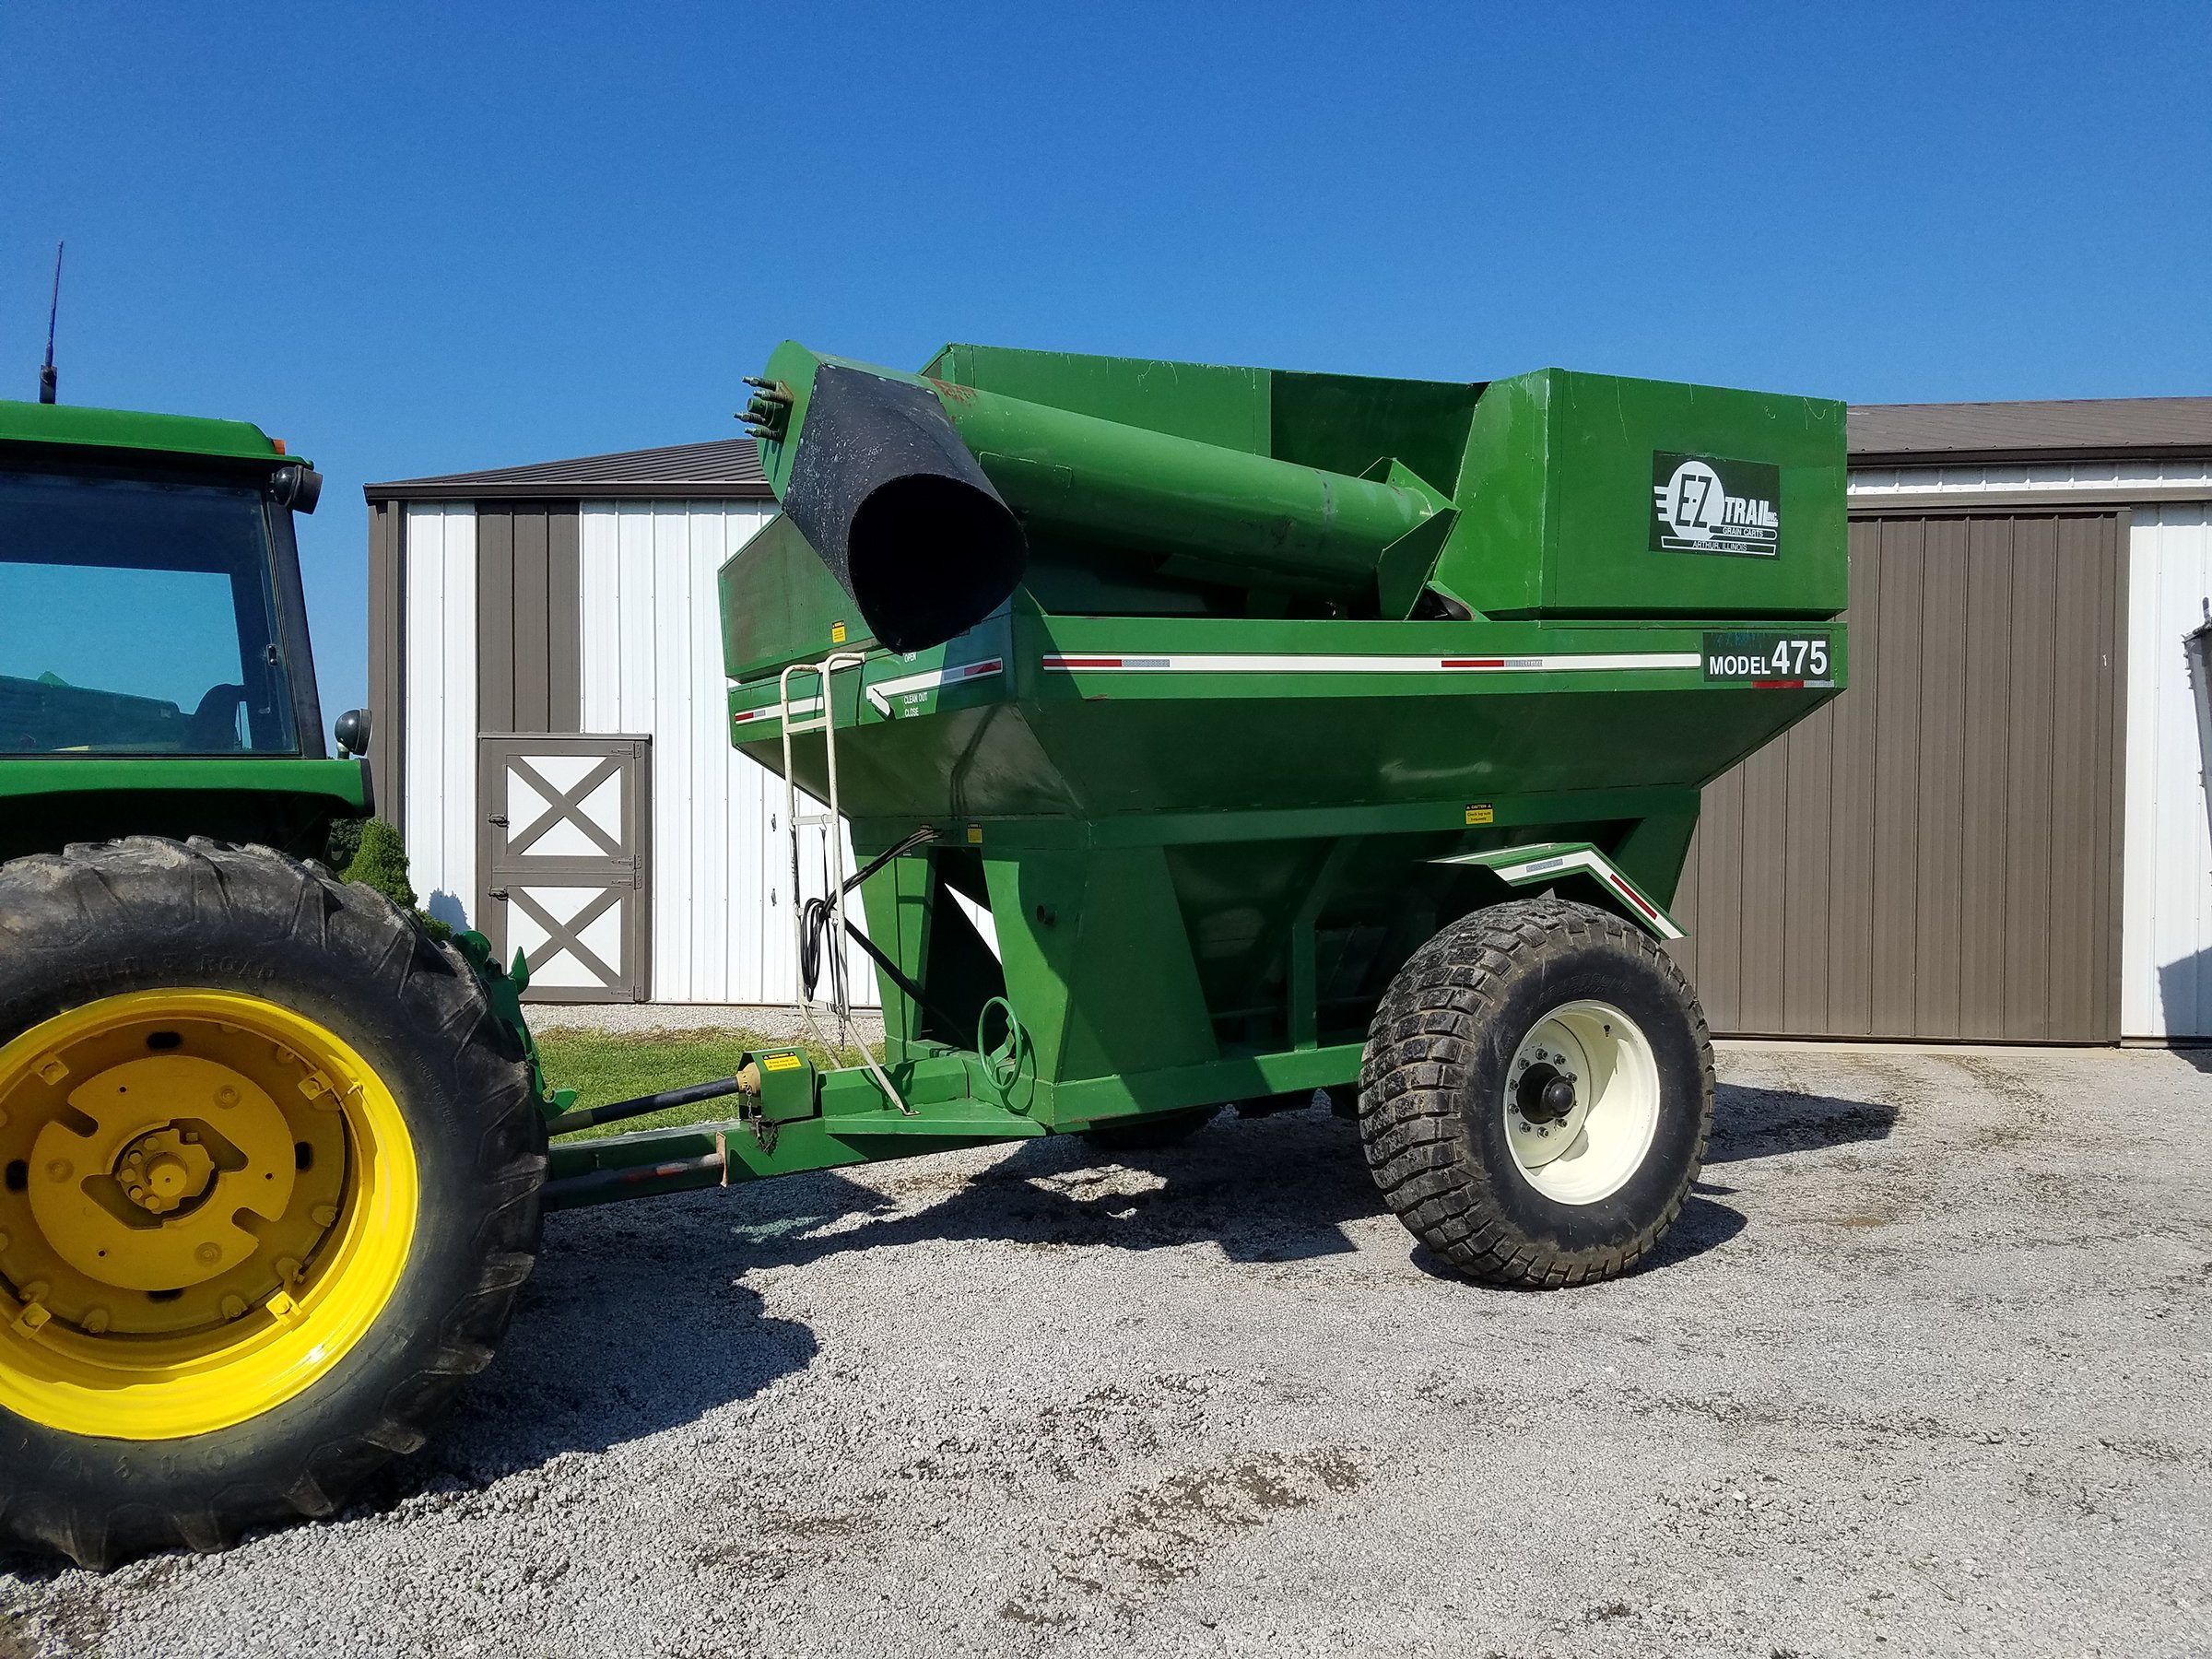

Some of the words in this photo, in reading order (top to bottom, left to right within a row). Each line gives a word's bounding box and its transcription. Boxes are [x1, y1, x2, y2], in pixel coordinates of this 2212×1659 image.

[1724, 496, 1779, 527] TRAIL
[1723, 526, 1742, 535] GRAIN
[1744, 528, 1764, 537] CARTS
[1722, 542, 1747, 552] ILLINOIS
[904, 652, 917, 664] OPEN
[1709, 655, 1771, 675] MODEL
[1771, 640, 1828, 675] 475
[904, 694, 919, 705] CLEAN
[919, 692, 928, 702] OUT
[904, 707, 920, 718] CLOSE
